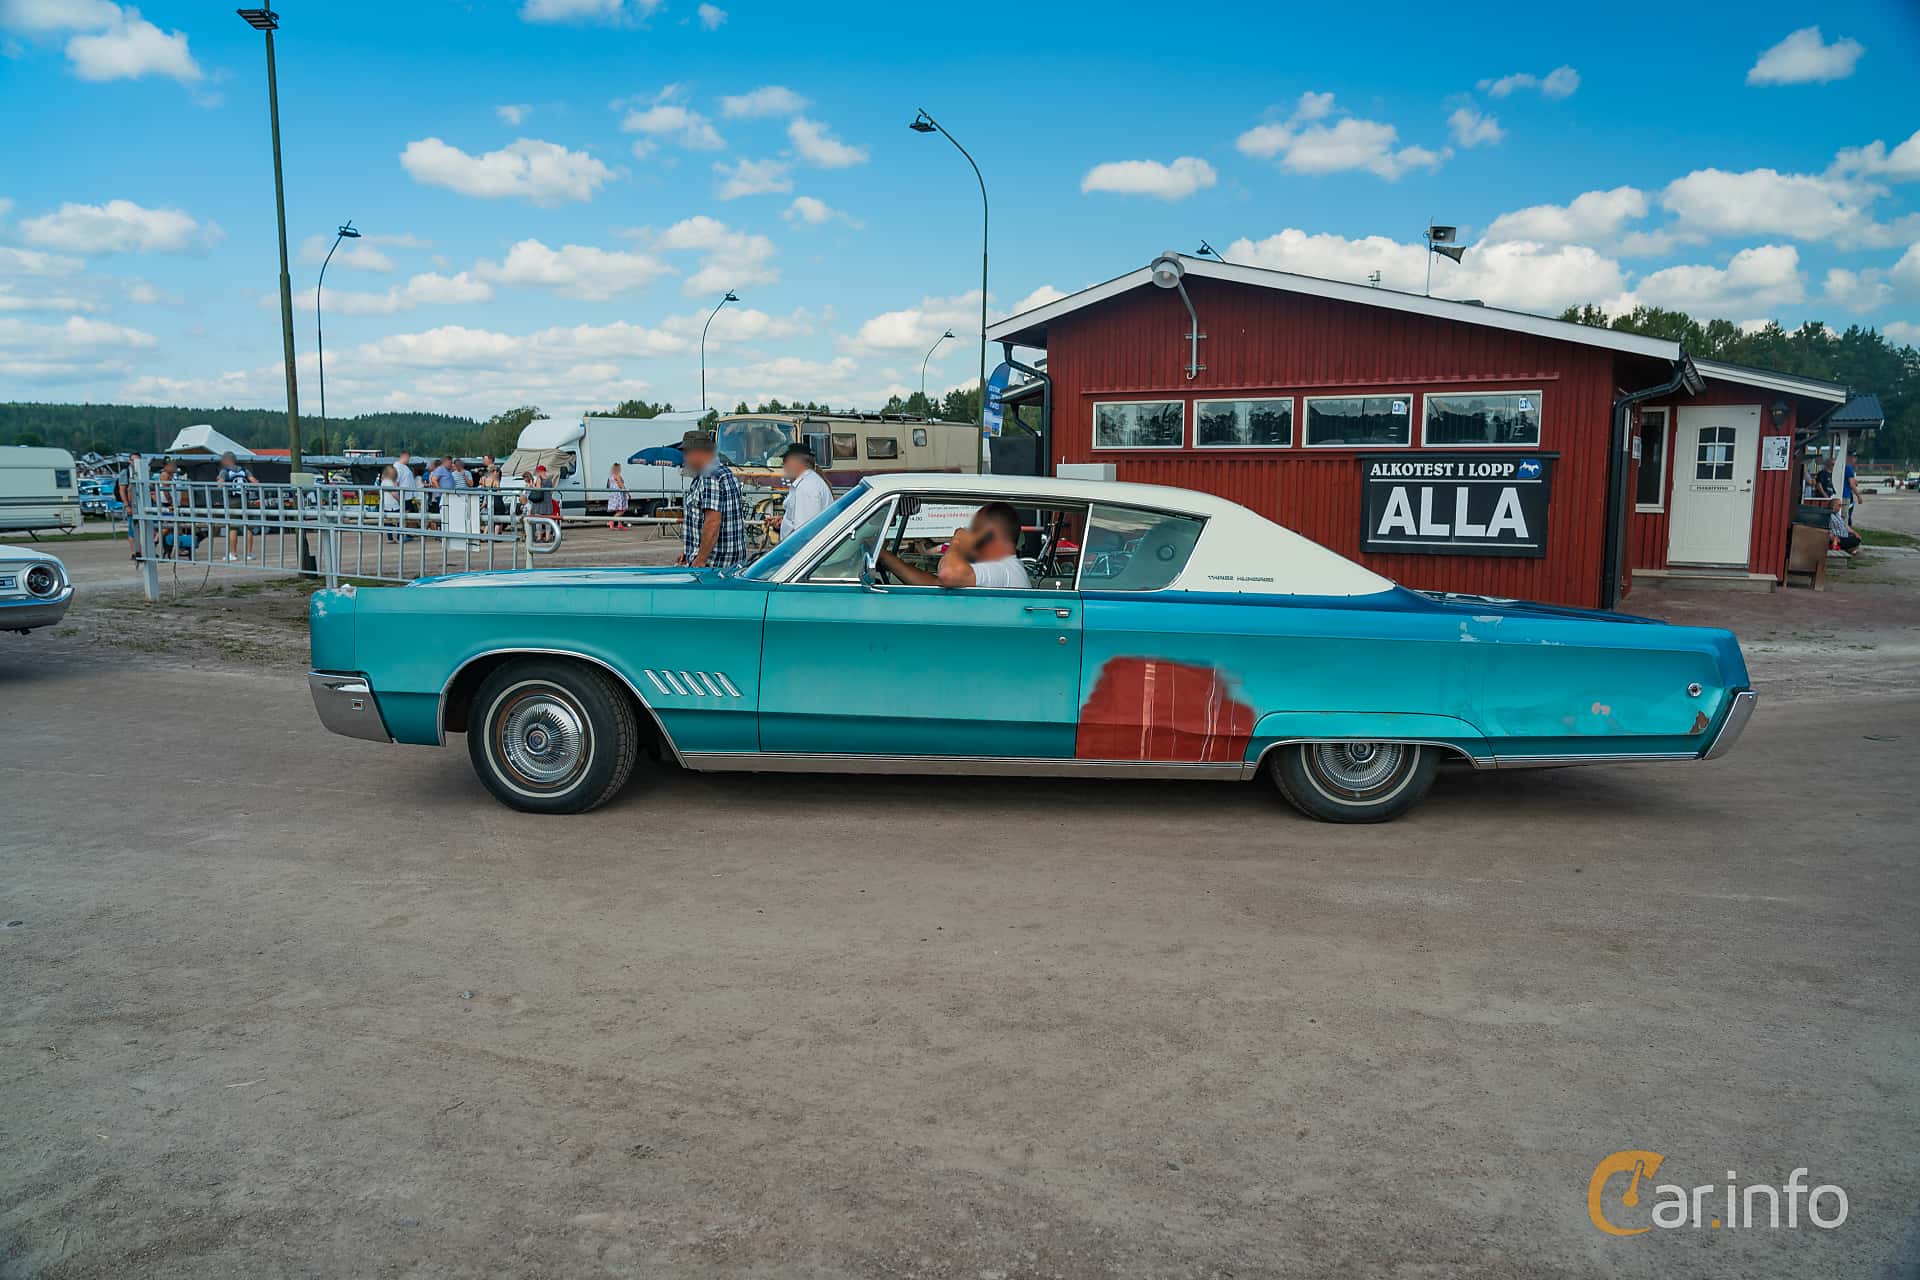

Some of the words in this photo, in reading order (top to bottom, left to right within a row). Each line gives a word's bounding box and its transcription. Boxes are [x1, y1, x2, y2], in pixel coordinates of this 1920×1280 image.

[1370, 463, 1454, 476] ALKOTEST
[1457, 463, 1464, 476] I
[1469, 463, 1515, 477] LOPP
[1377, 486, 1529, 538] ALLA
